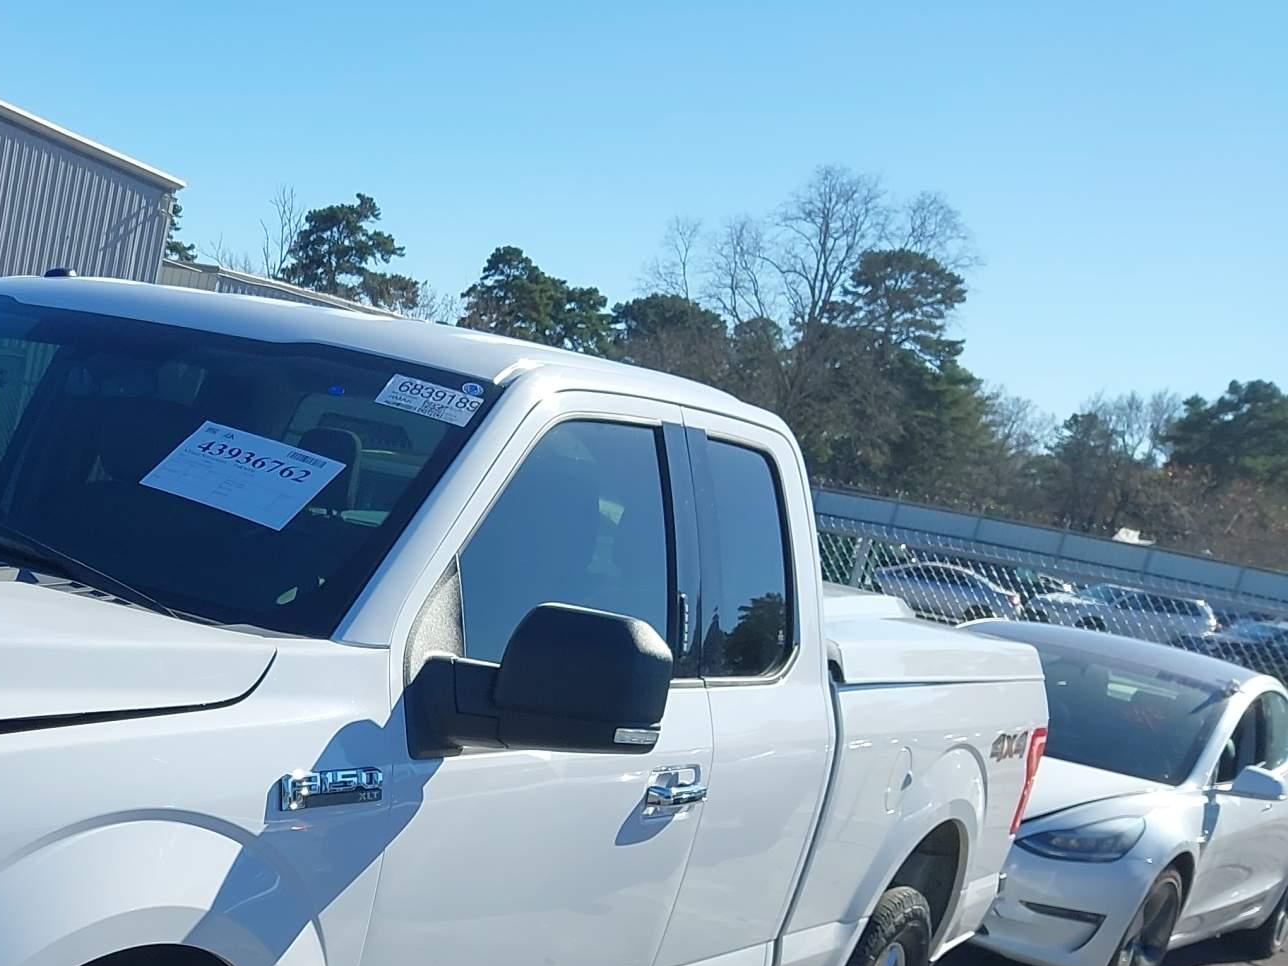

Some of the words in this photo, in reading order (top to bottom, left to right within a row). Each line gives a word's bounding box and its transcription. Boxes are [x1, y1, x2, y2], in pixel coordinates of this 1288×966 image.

[398, 381, 481, 412] 6839189
[197, 440, 312, 483] 43936762
[359, 791, 379, 801] XLT
